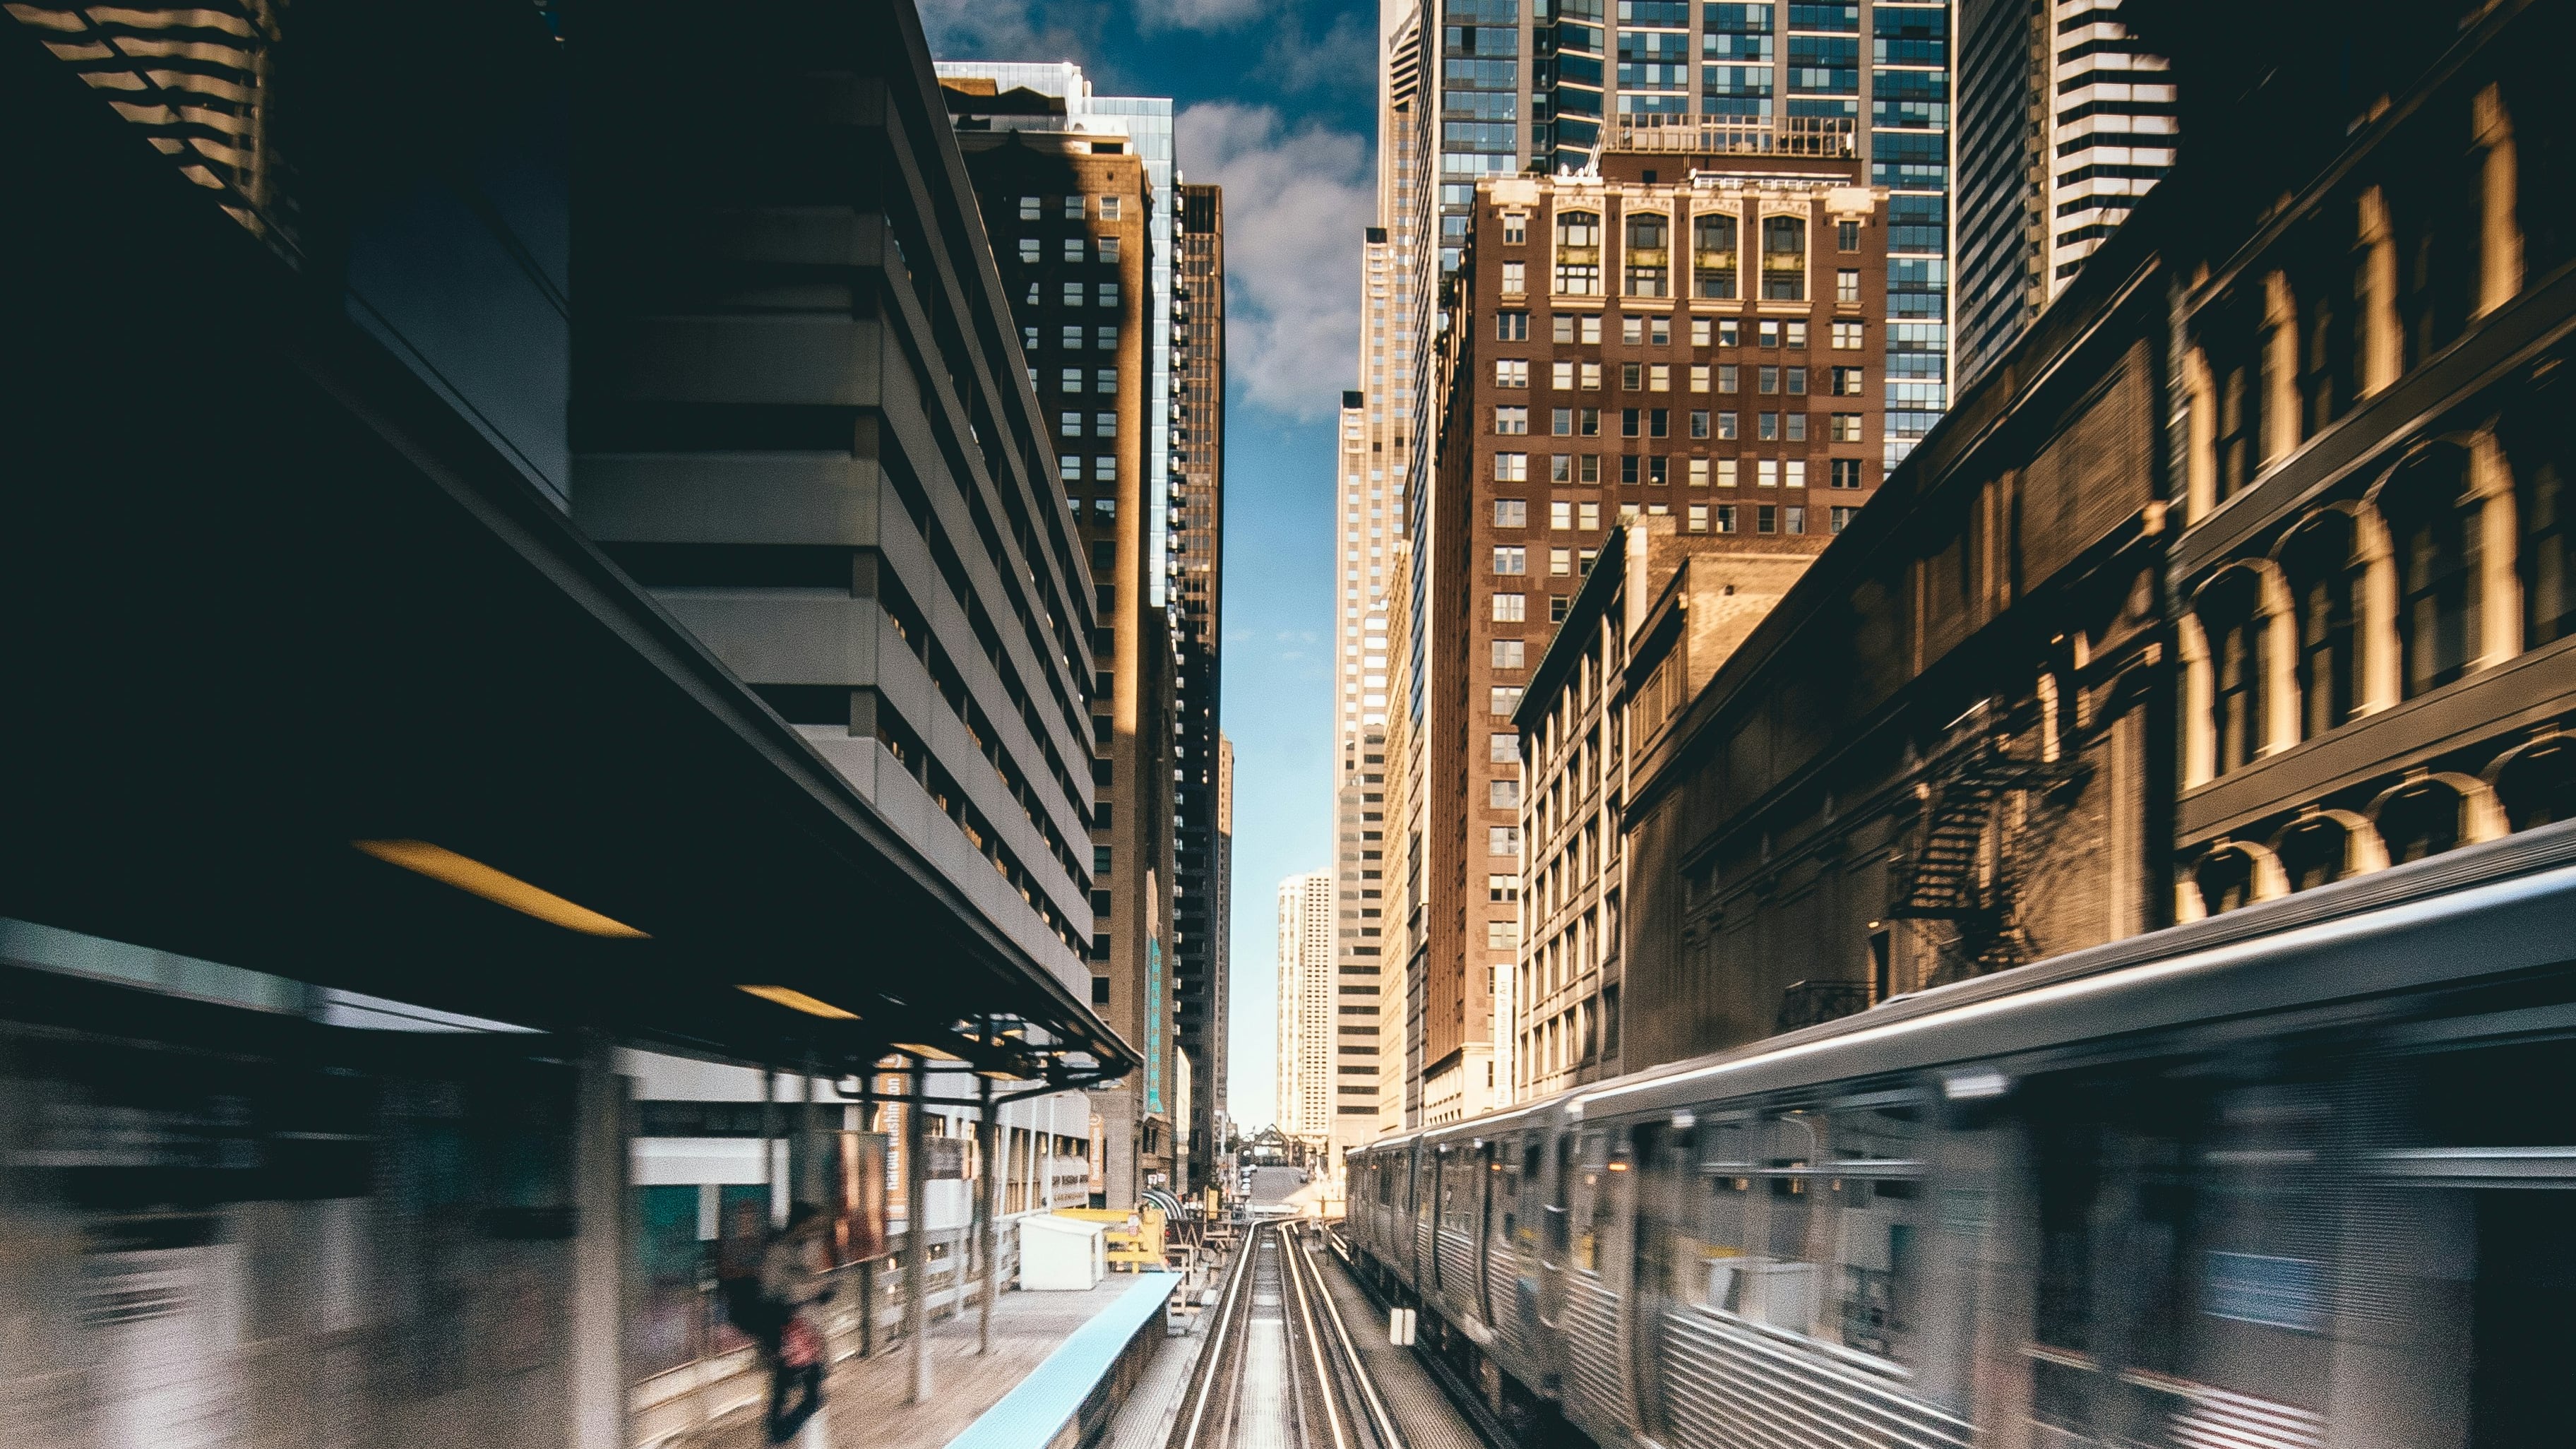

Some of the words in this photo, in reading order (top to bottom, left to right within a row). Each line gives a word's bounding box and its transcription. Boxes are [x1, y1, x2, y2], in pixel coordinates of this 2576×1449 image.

[1499, 981, 1508, 995] Art
[1499, 998, 1507, 1007] of
[1498, 1011, 1507, 1050] Institute
[883, 1078, 900, 1147] washinon
